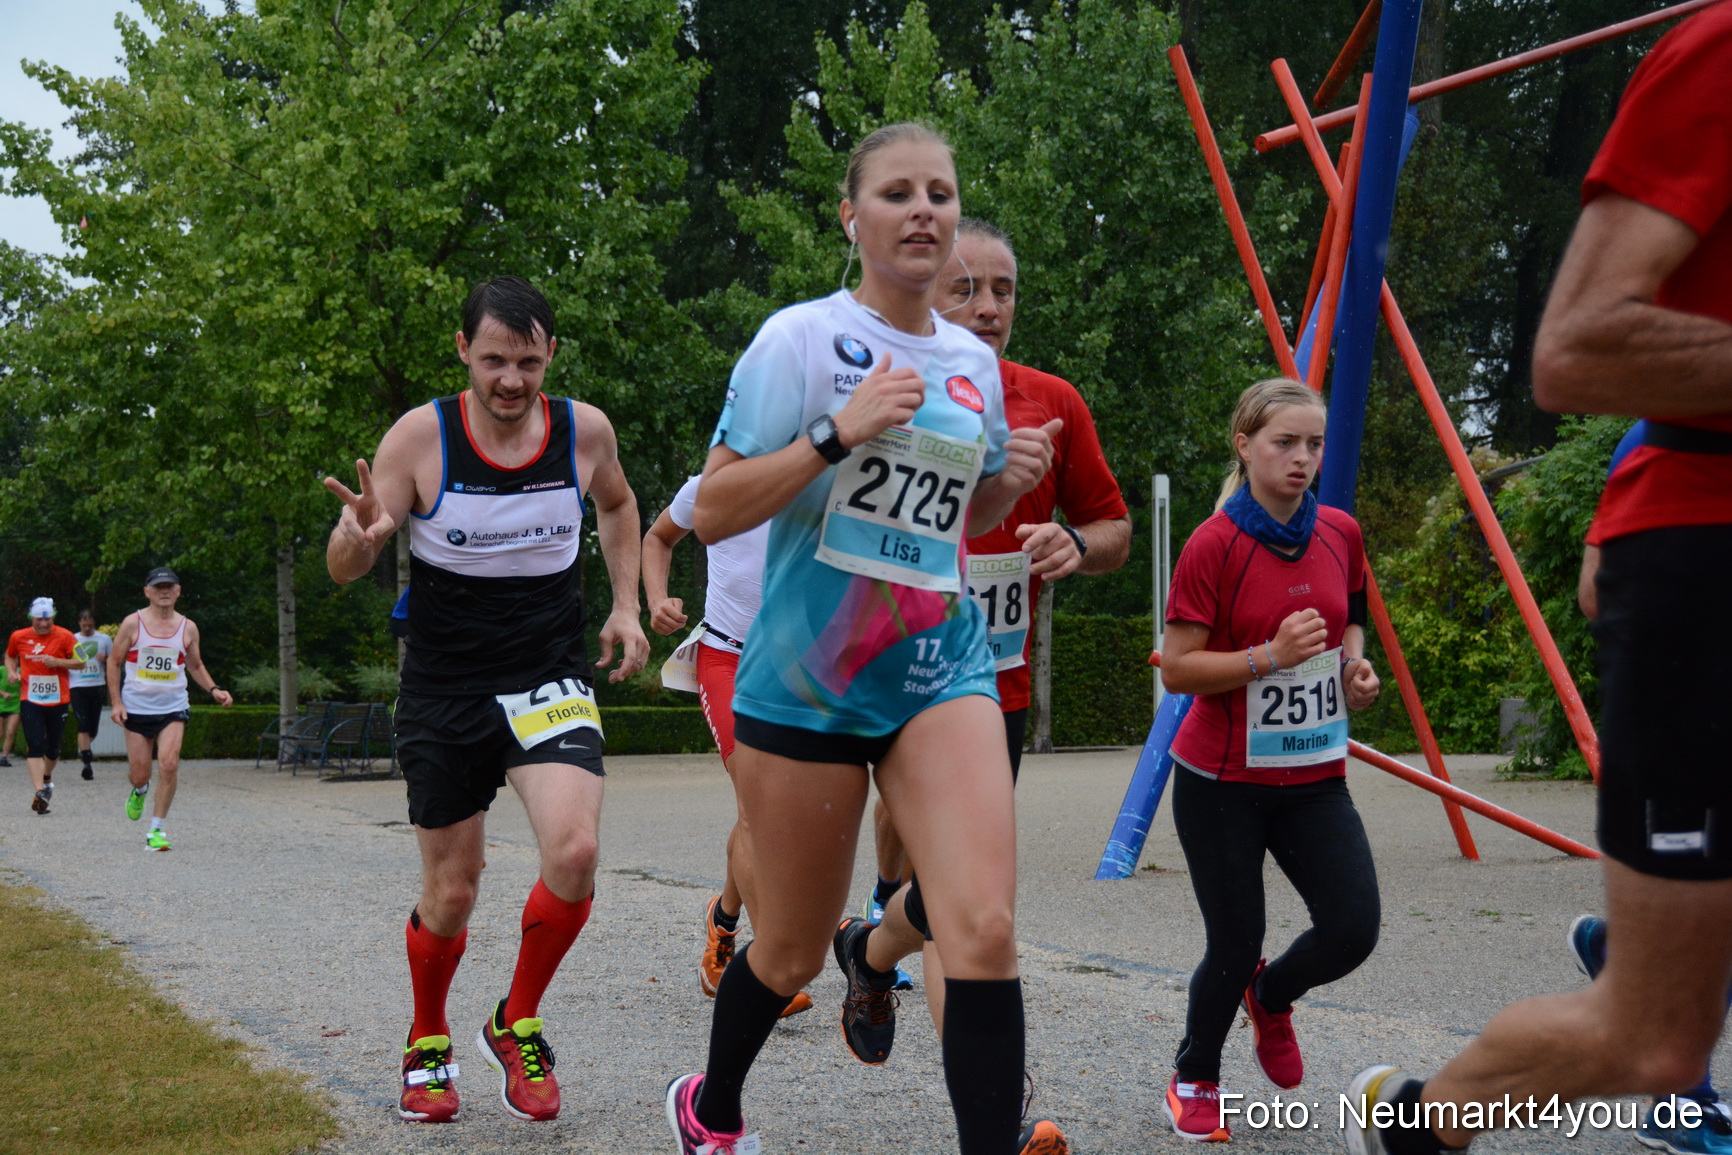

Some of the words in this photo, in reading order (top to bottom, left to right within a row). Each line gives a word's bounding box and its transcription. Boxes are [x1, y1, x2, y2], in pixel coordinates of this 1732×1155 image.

[917, 434, 977, 467] BOCK
[847, 456, 966, 532] 2725
[470, 531, 519, 541] Autohaus
[521, 528, 532, 538] J.
[535, 527, 547, 537] B.
[880, 533, 921, 564] Lisa
[970, 556, 1024, 574] BOCK
[1288, 583, 1310, 594] GORE
[145, 655, 172, 671] 296
[1301, 652, 1337, 674] BOCK
[32, 682, 58, 694] 2695
[1260, 675, 1338, 726] 2519
[546, 703, 592, 724] Flocke
[1282, 733, 1329, 752] Marina
